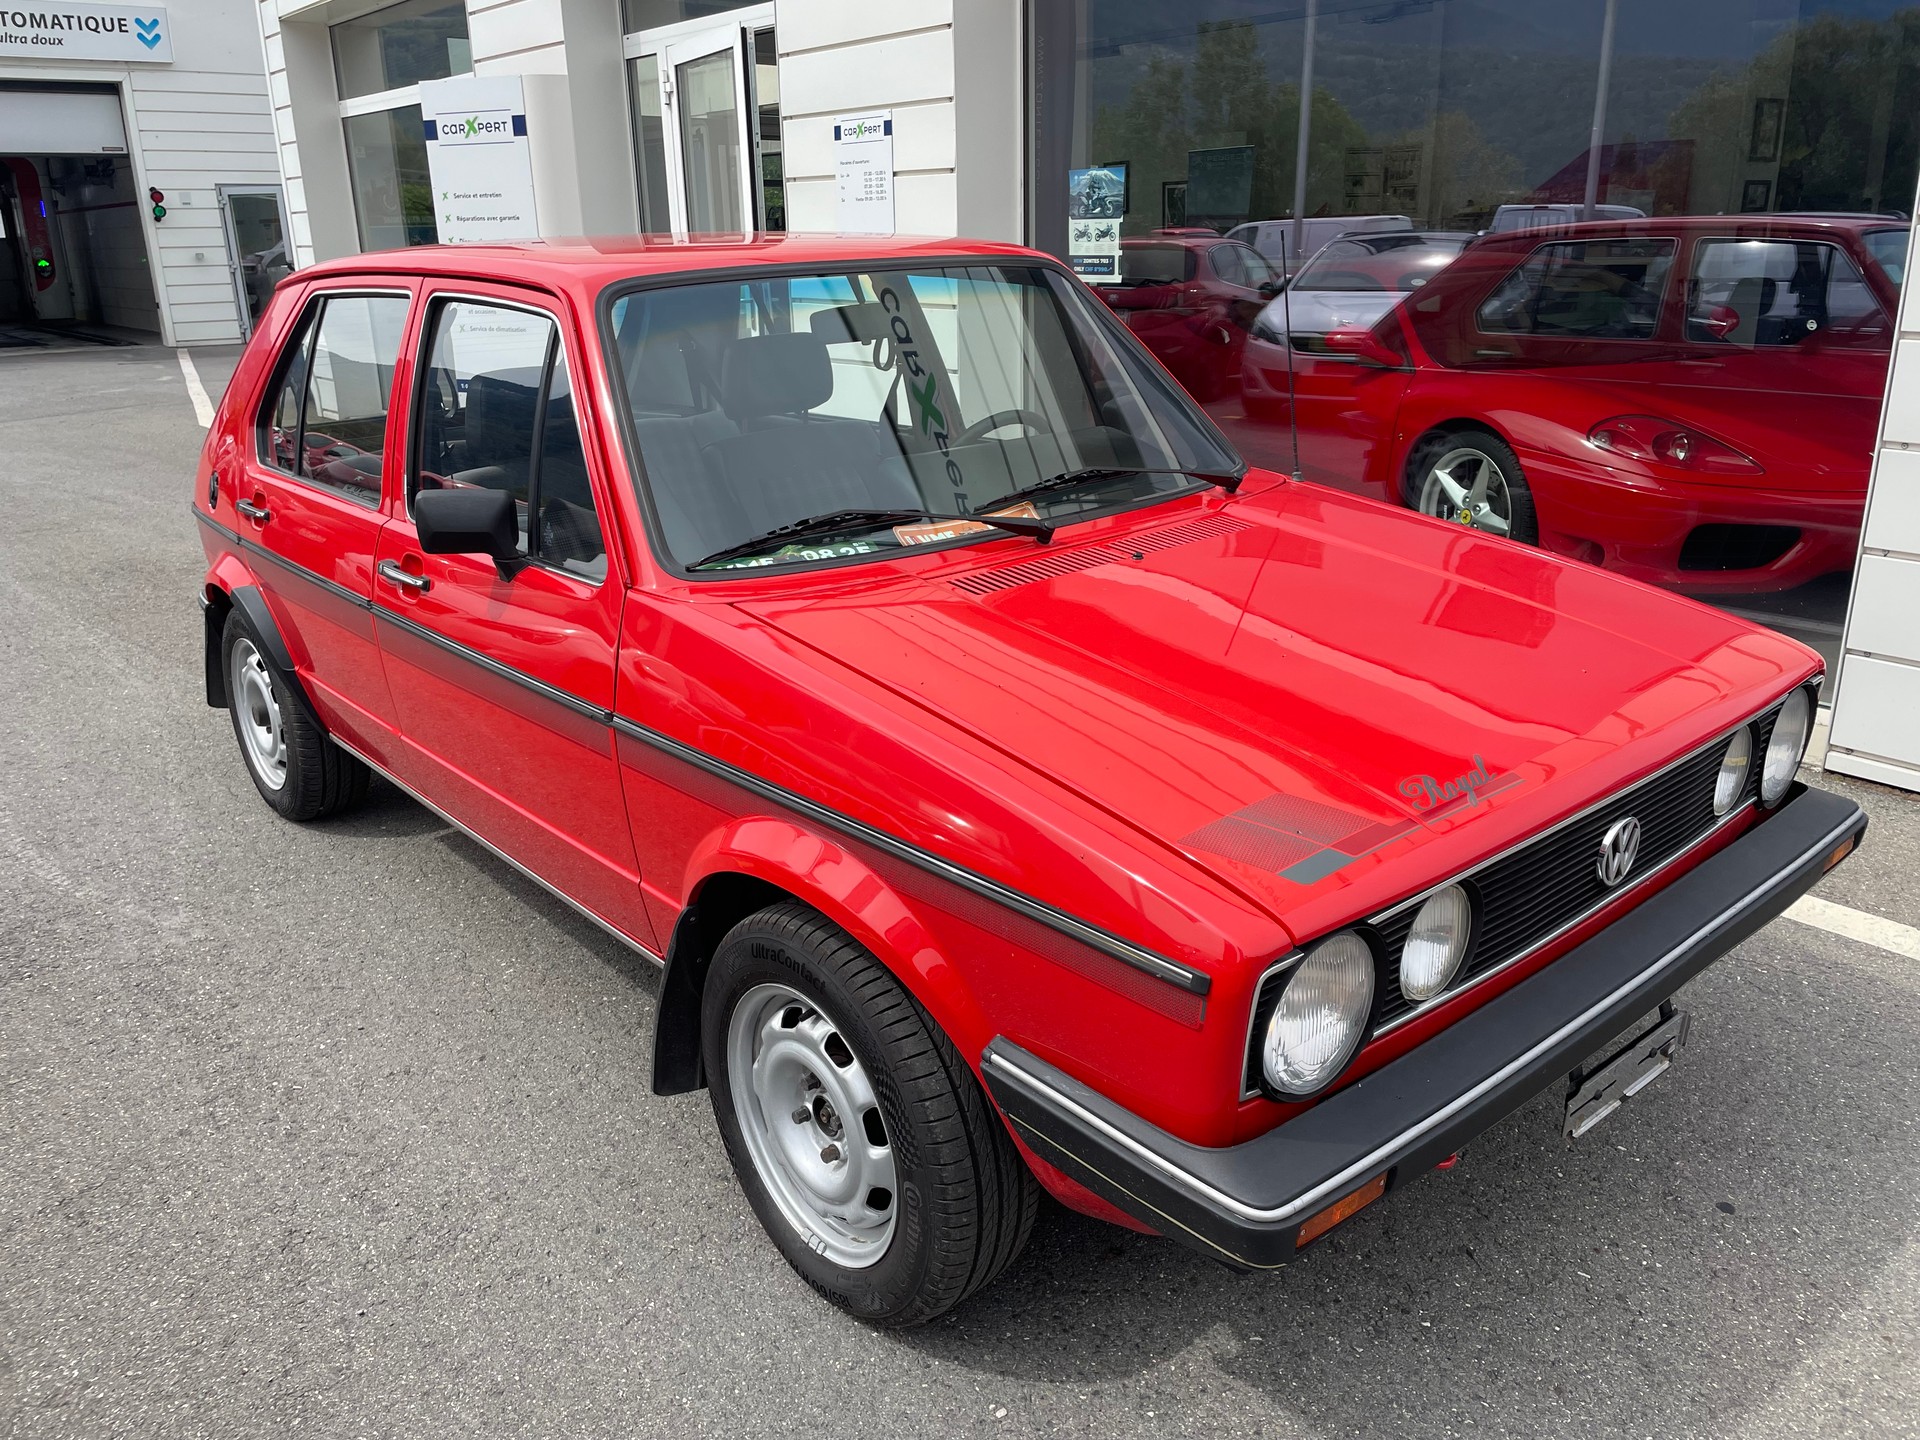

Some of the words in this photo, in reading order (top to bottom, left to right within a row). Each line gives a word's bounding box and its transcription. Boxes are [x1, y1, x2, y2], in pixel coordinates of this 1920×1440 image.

[31, 33, 64, 46] doux
[1399, 754, 1497, 810] Royal
[751, 942, 826, 992] UltraContact
